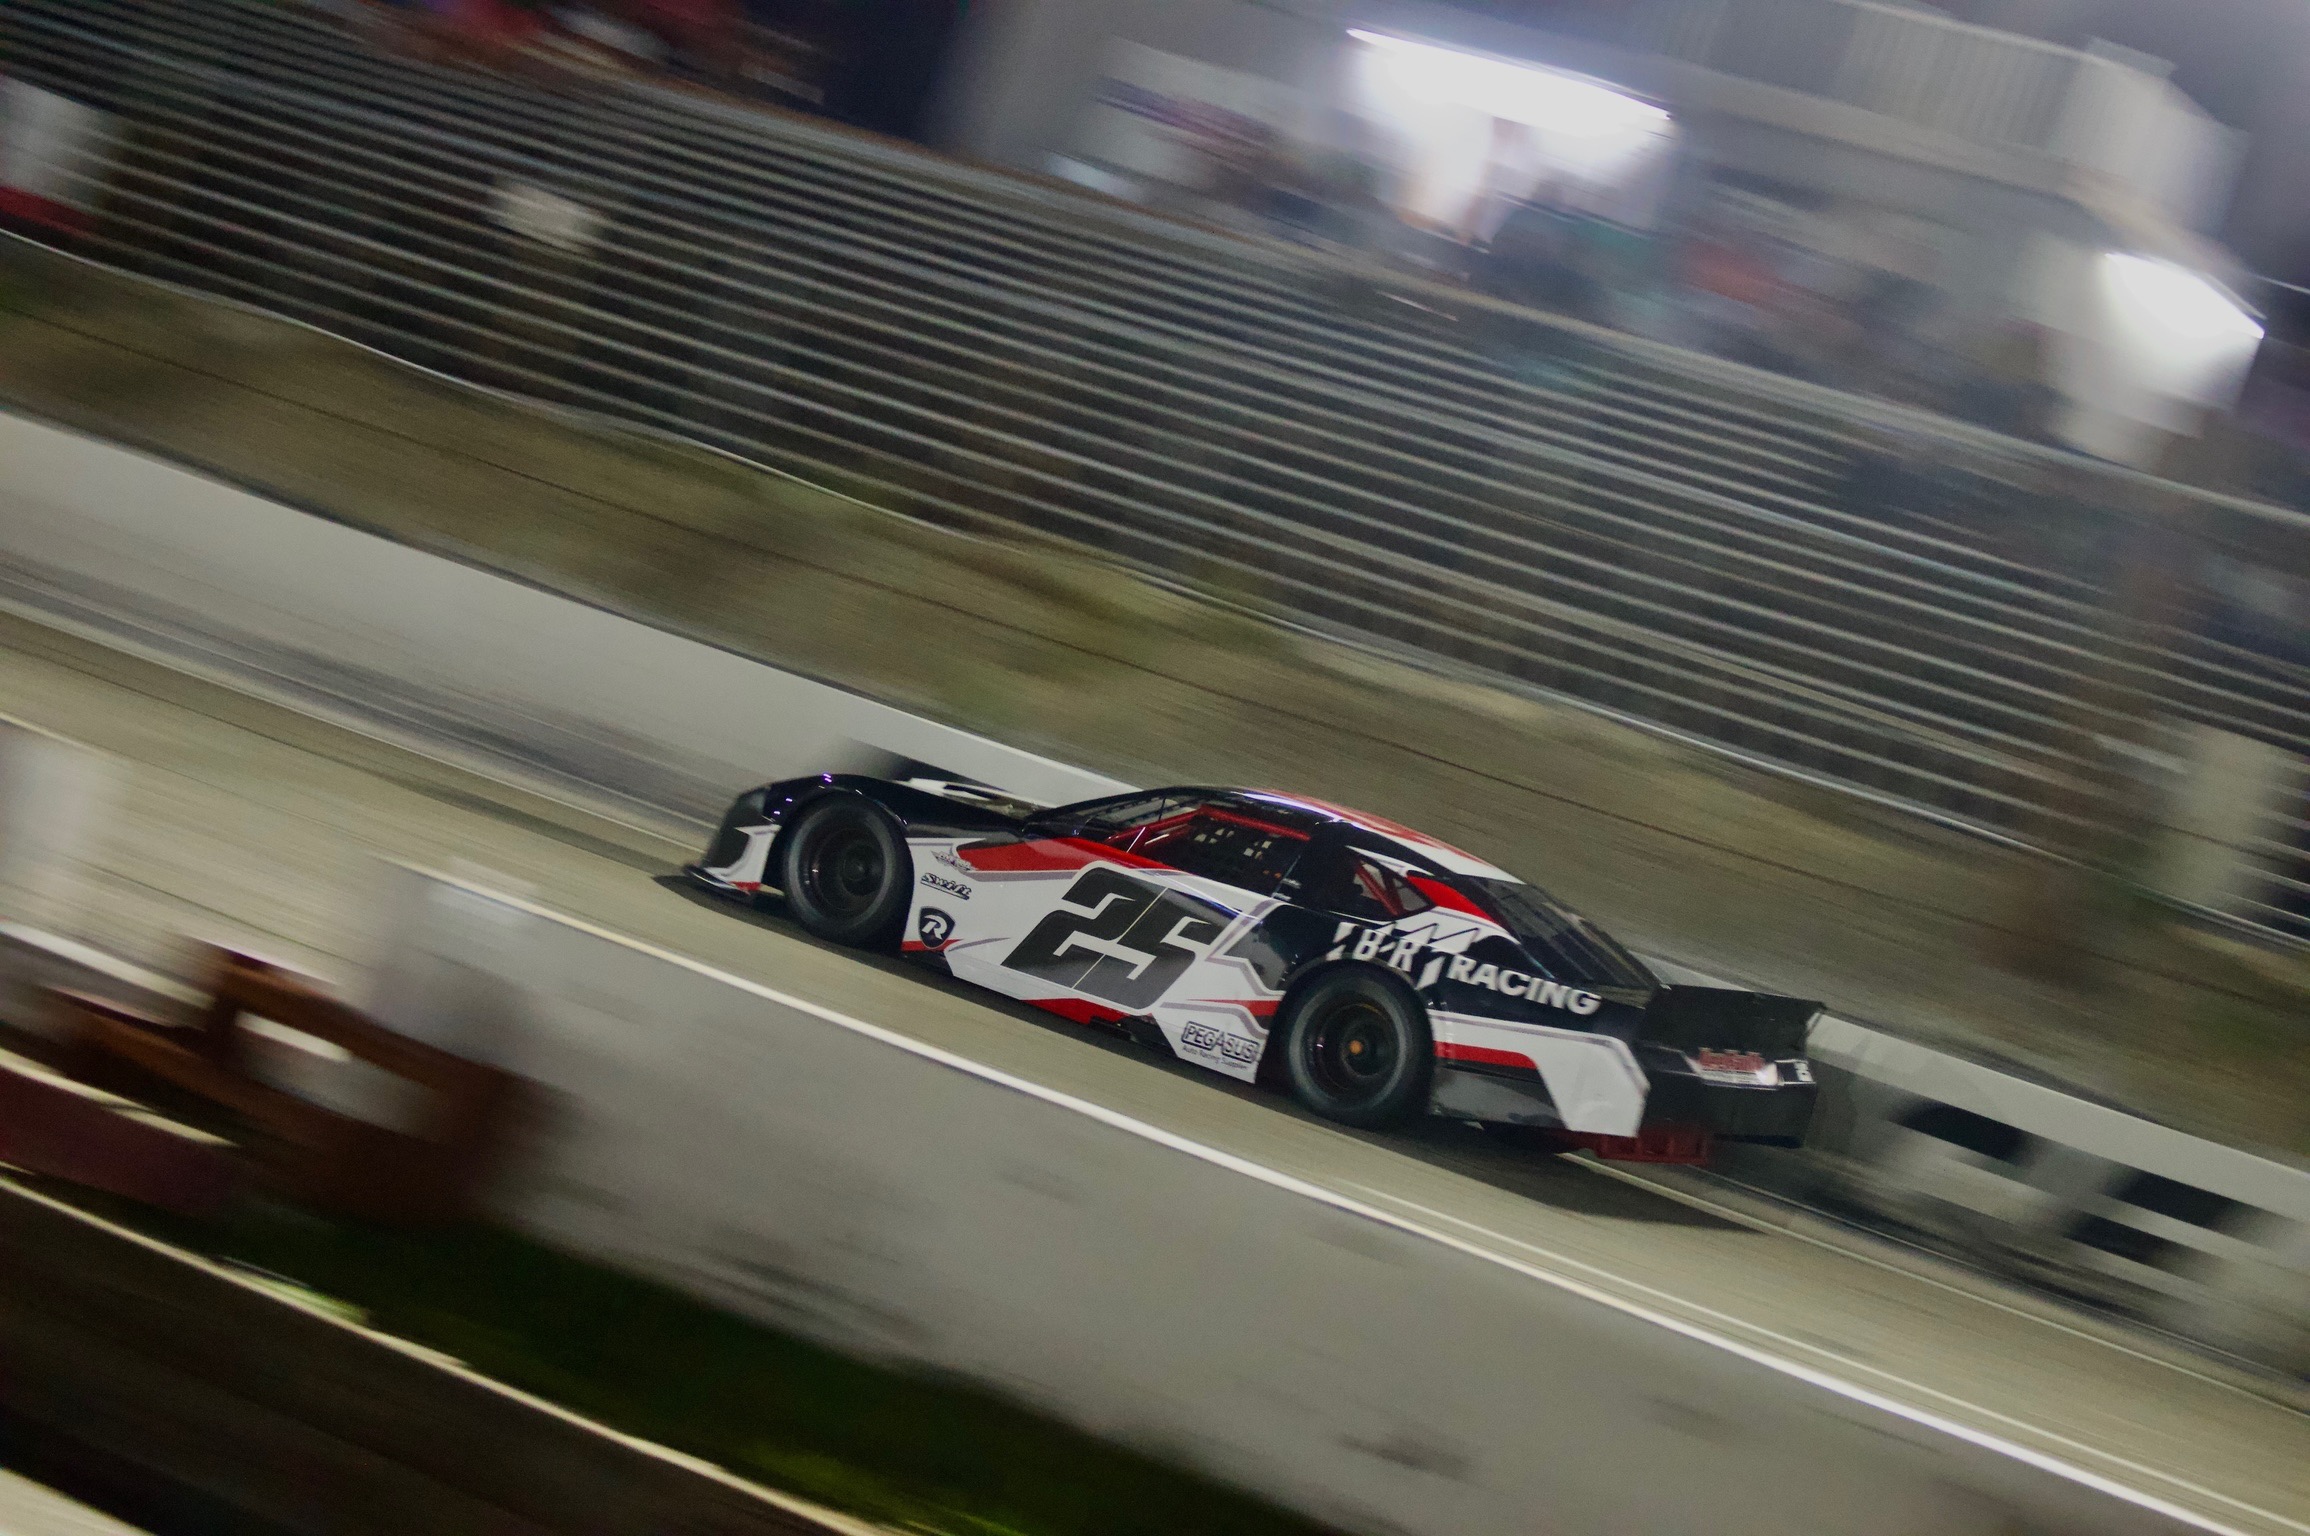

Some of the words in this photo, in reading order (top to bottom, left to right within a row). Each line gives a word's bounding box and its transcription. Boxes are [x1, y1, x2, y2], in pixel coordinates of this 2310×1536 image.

[921, 873, 972, 897] Swift
[1000, 866, 1239, 1009] 25
[1446, 953, 1602, 1017] RACING
[1184, 1025, 1257, 1060] PEGASUS
